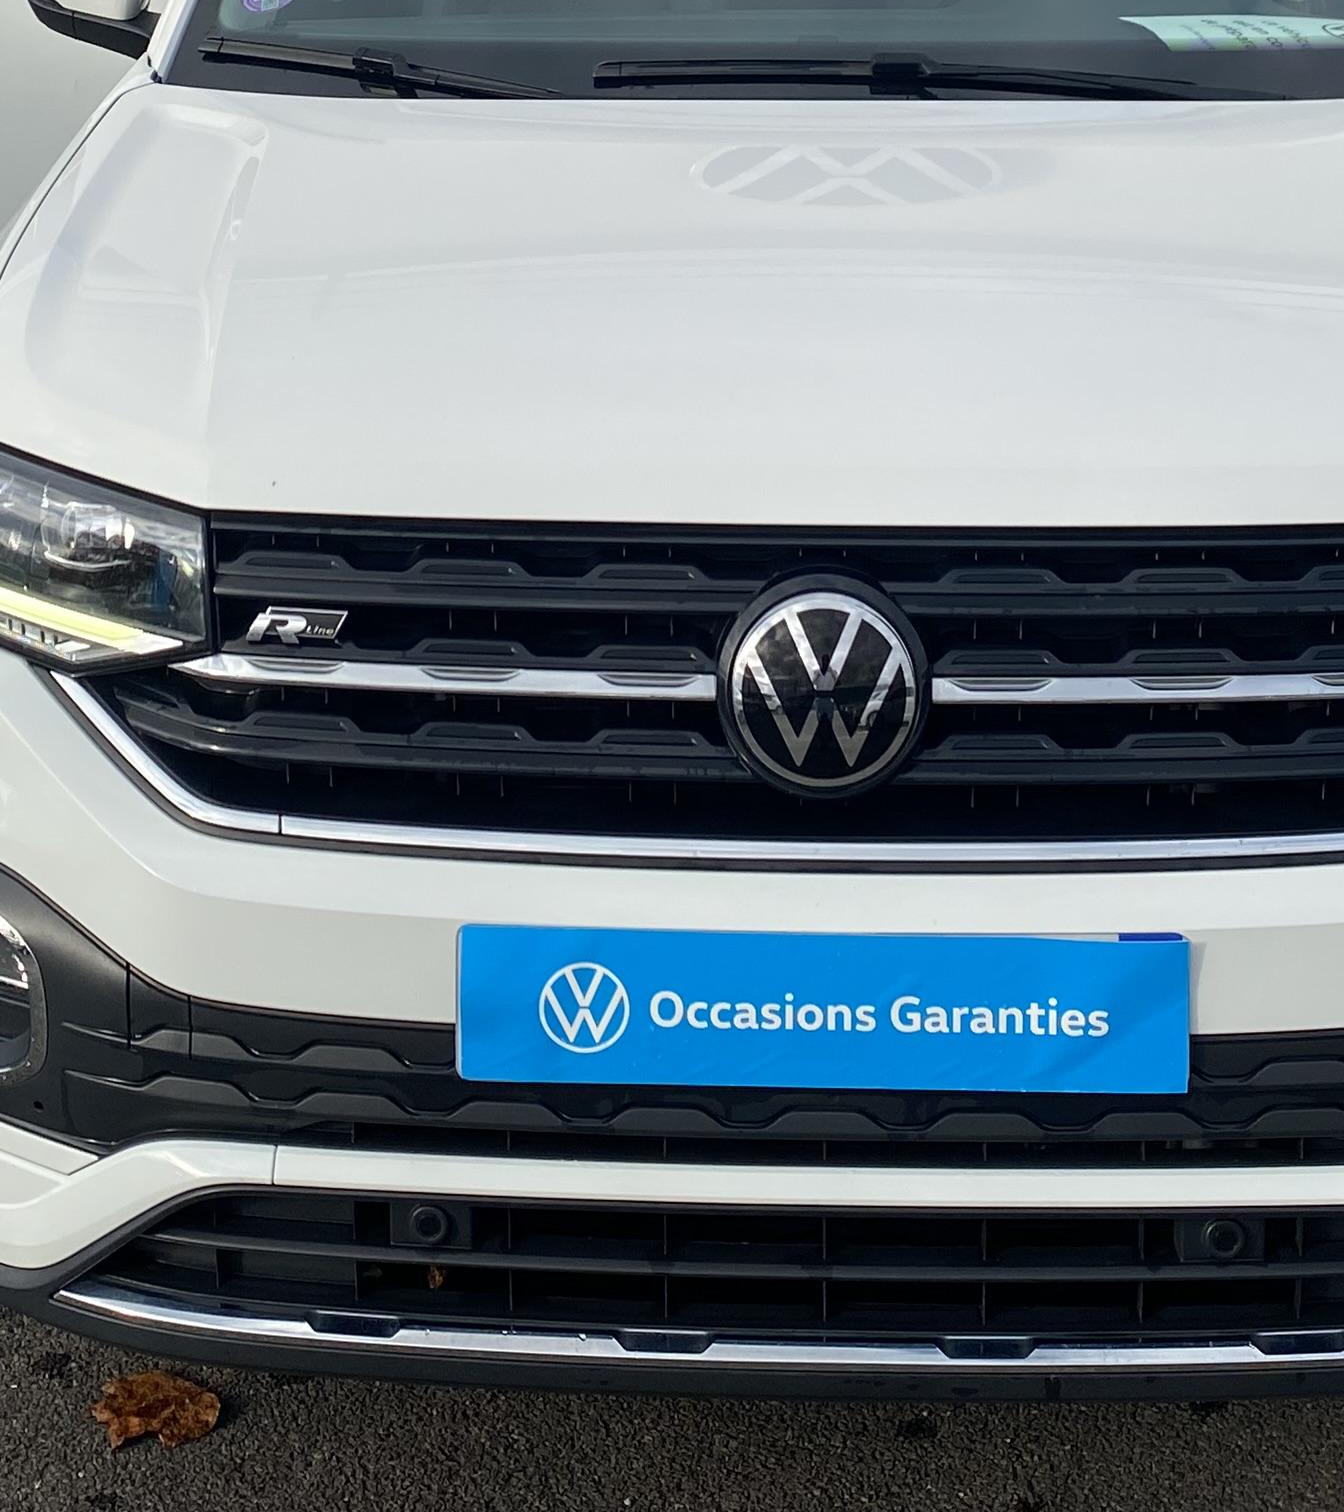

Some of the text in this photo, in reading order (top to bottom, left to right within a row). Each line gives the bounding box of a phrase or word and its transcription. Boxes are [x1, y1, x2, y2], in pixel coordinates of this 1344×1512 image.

[733, 593, 915, 784] VW
[539, 961, 1110, 1054] VW Occasions Garanties
